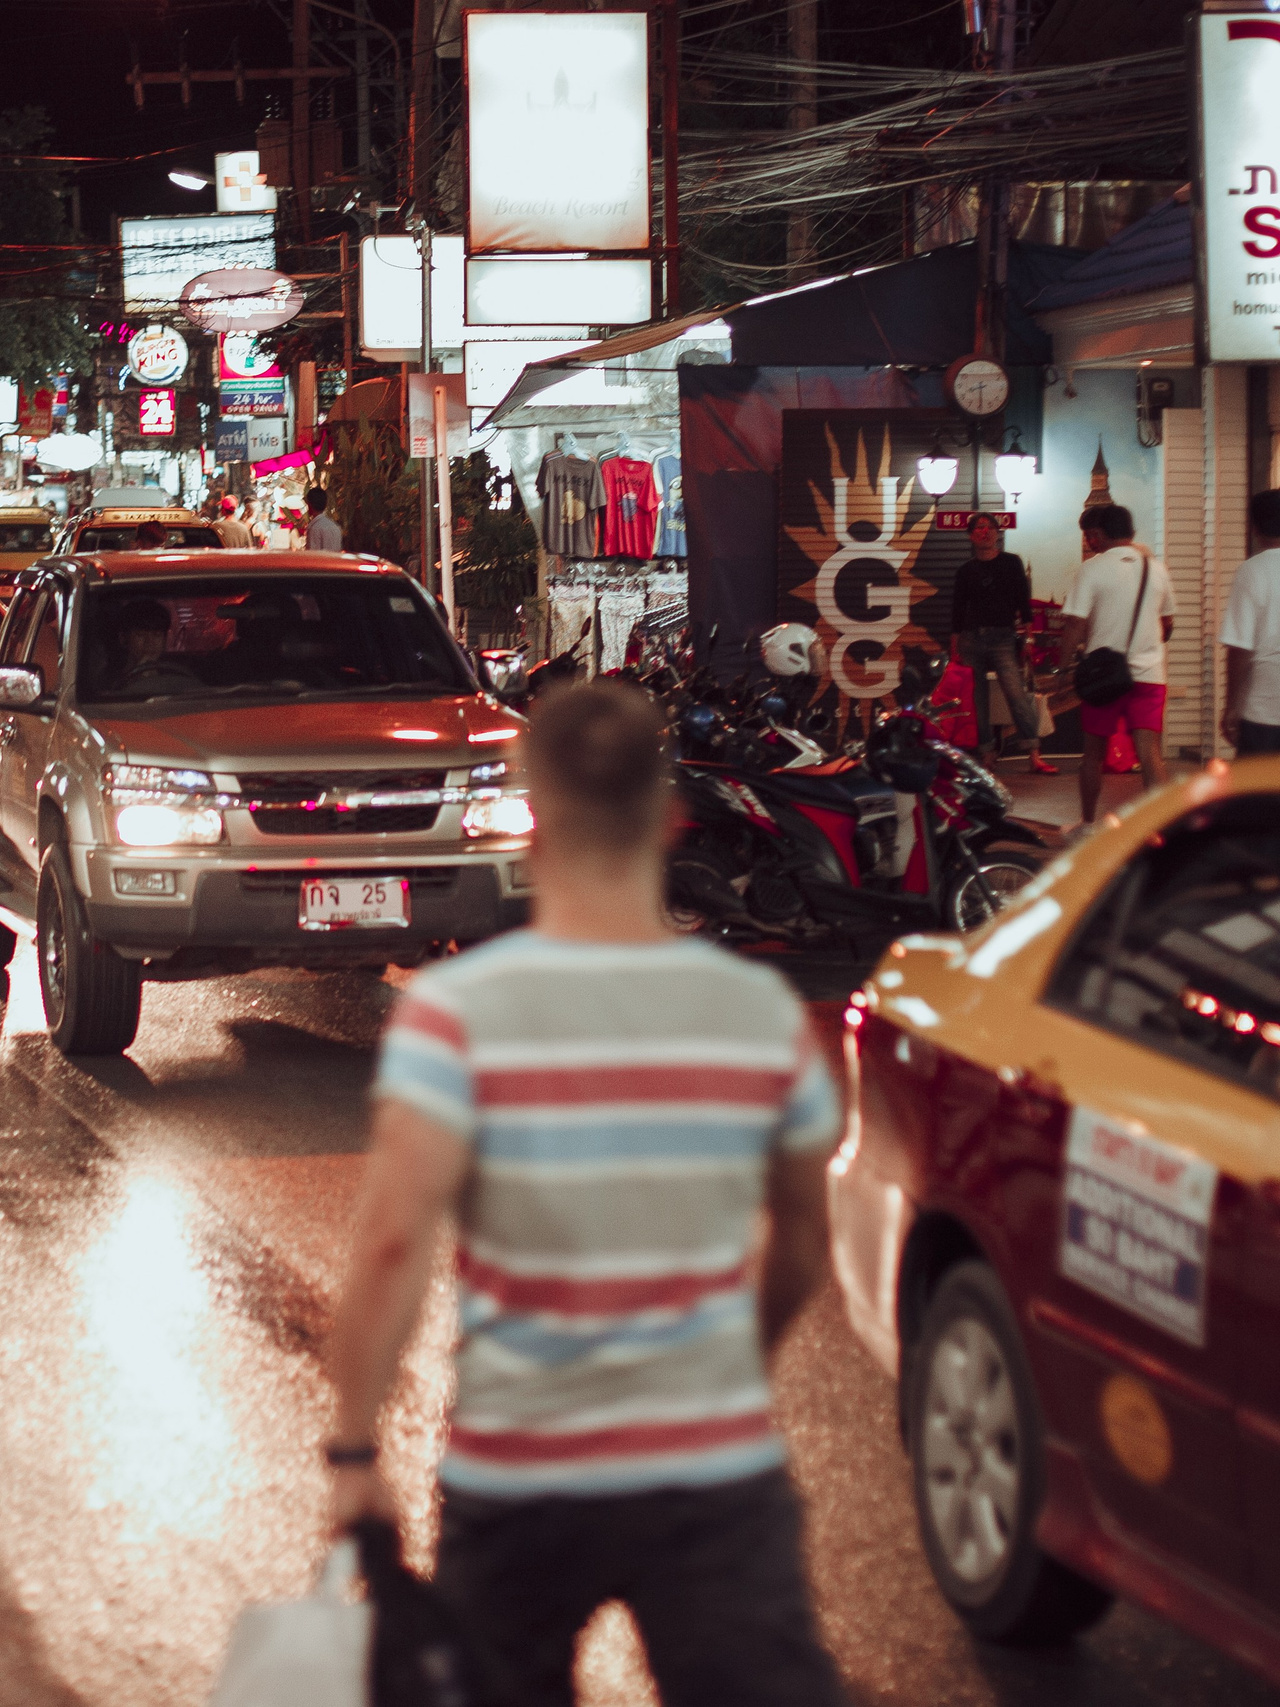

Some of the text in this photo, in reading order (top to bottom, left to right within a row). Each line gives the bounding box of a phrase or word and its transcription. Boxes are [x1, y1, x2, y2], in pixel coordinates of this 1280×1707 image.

[1242, 205, 1280, 259] S
[137, 347, 178, 372] KING
[233, 394, 251, 405] 24
[141, 399, 174, 424] 24
[217, 431, 280, 447] ATM TMB
[361, 883, 387, 904] 25
